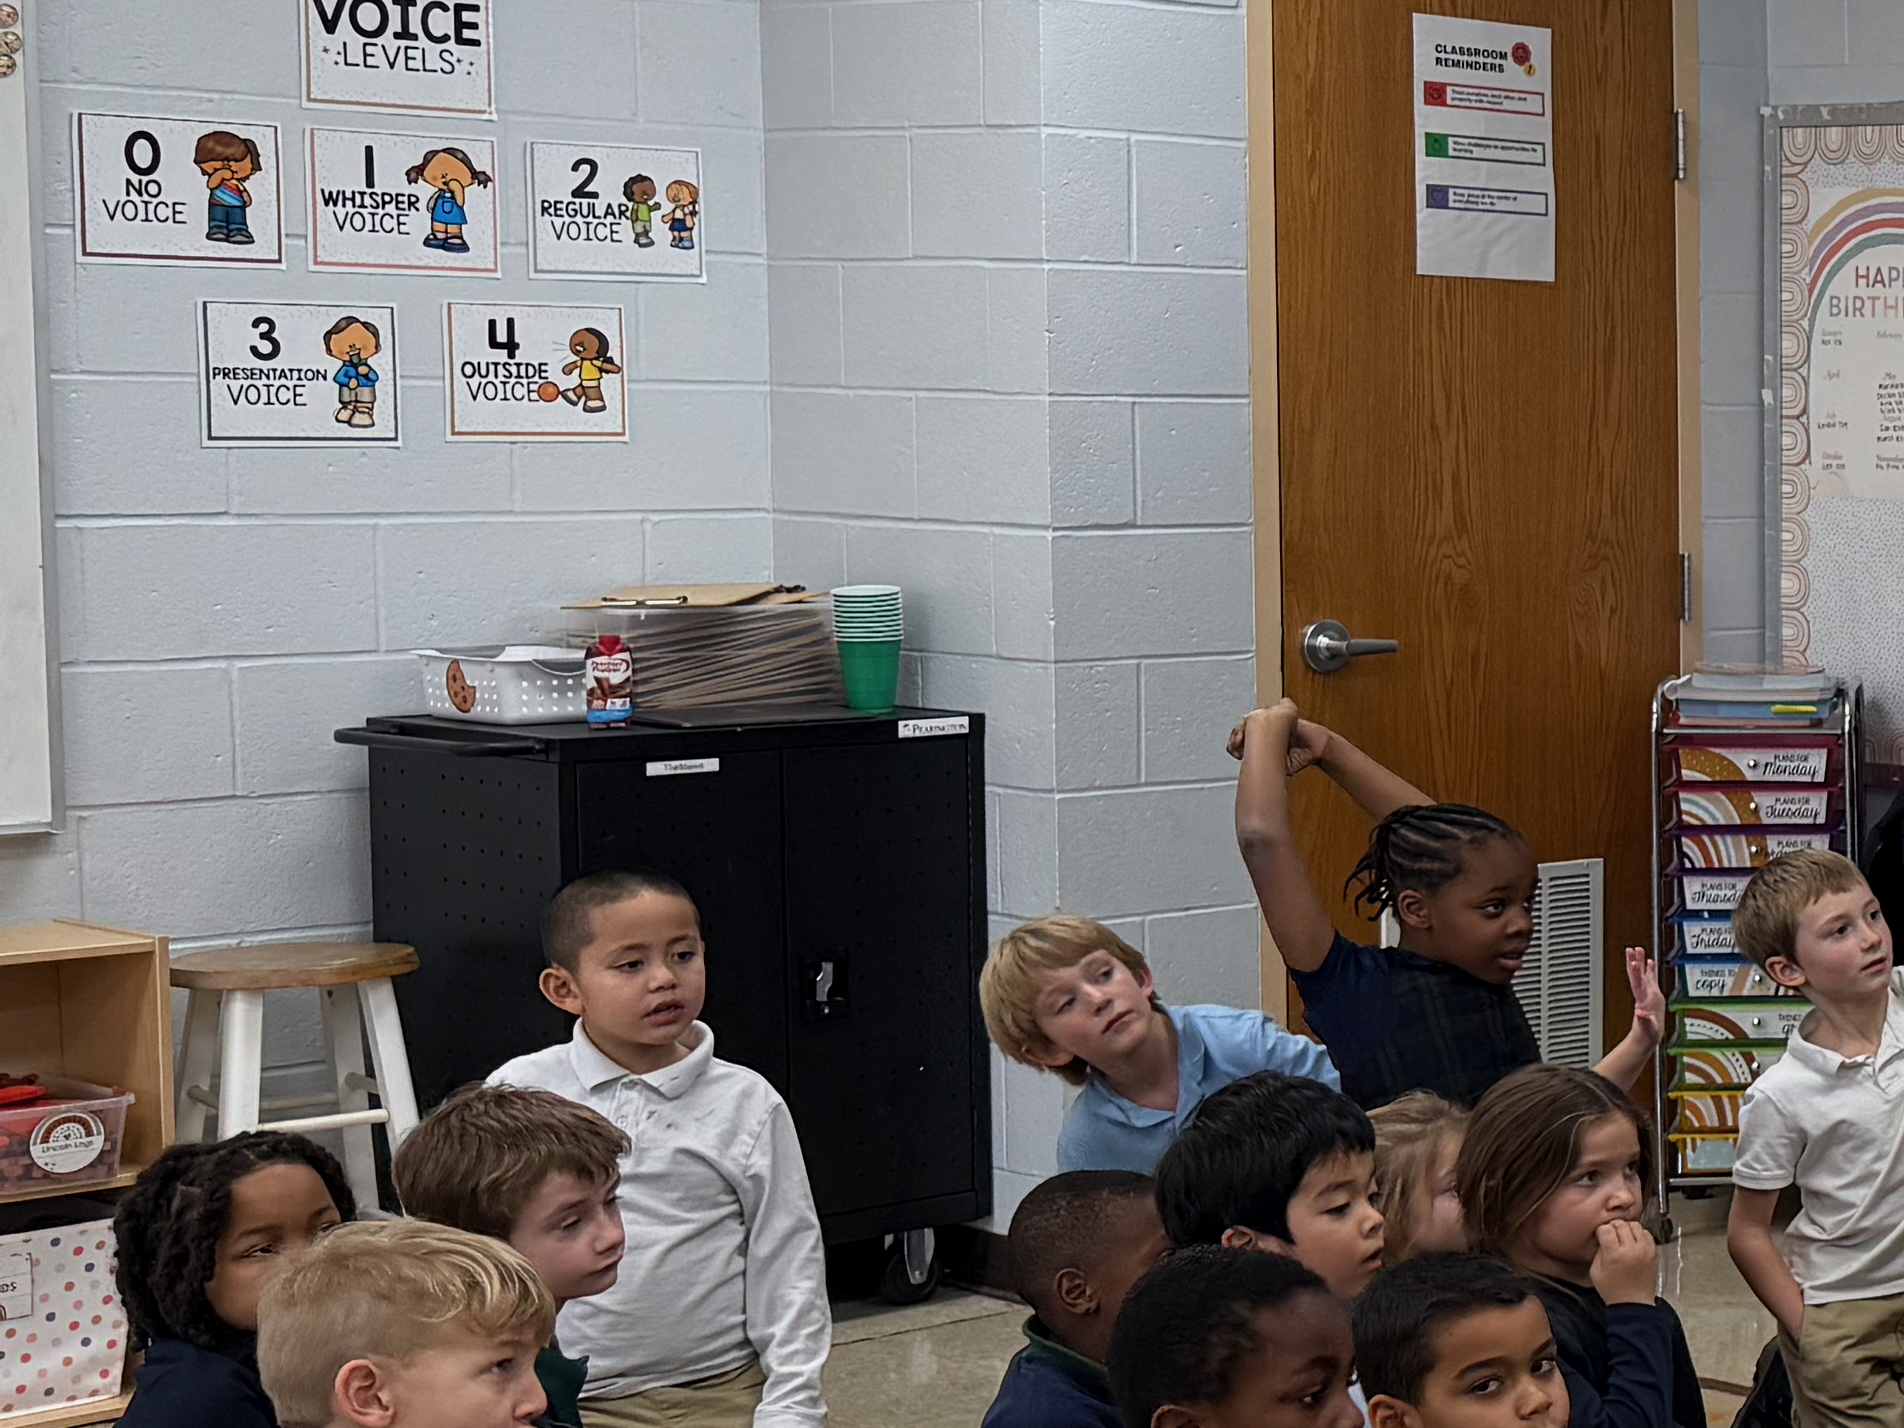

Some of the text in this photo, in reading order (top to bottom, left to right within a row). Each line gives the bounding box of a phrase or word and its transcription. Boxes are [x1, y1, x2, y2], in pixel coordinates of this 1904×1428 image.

[343, 42, 455, 74] LEVELS
[1435, 44, 1508, 61] CLASSROOM
[1435, 57, 1505, 73] REMINDERS
[124, 131, 161, 176] 0
[365, 145, 375, 188] 1
[126, 178, 161, 198] NO
[571, 157, 599, 199] 2
[102, 199, 187, 224] VOICE
[321, 189, 419, 212] WHISPER
[540, 200, 629, 220] REGULAR
[333, 211, 410, 235] VOICE
[551, 220, 622, 243] VOICE
[249, 317, 281, 361] 3
[488, 317, 520, 359] 4
[212, 368, 327, 382] PRESENTATION
[460, 362, 549, 380] OUTSIDE
[227, 384, 306, 406] VOICE
[467, 381, 539, 402] VOICE
[1763, 763, 1819, 781] Monday
[1766, 805, 1820, 822] Tuesday
[1695, 978, 1726, 995] copy
